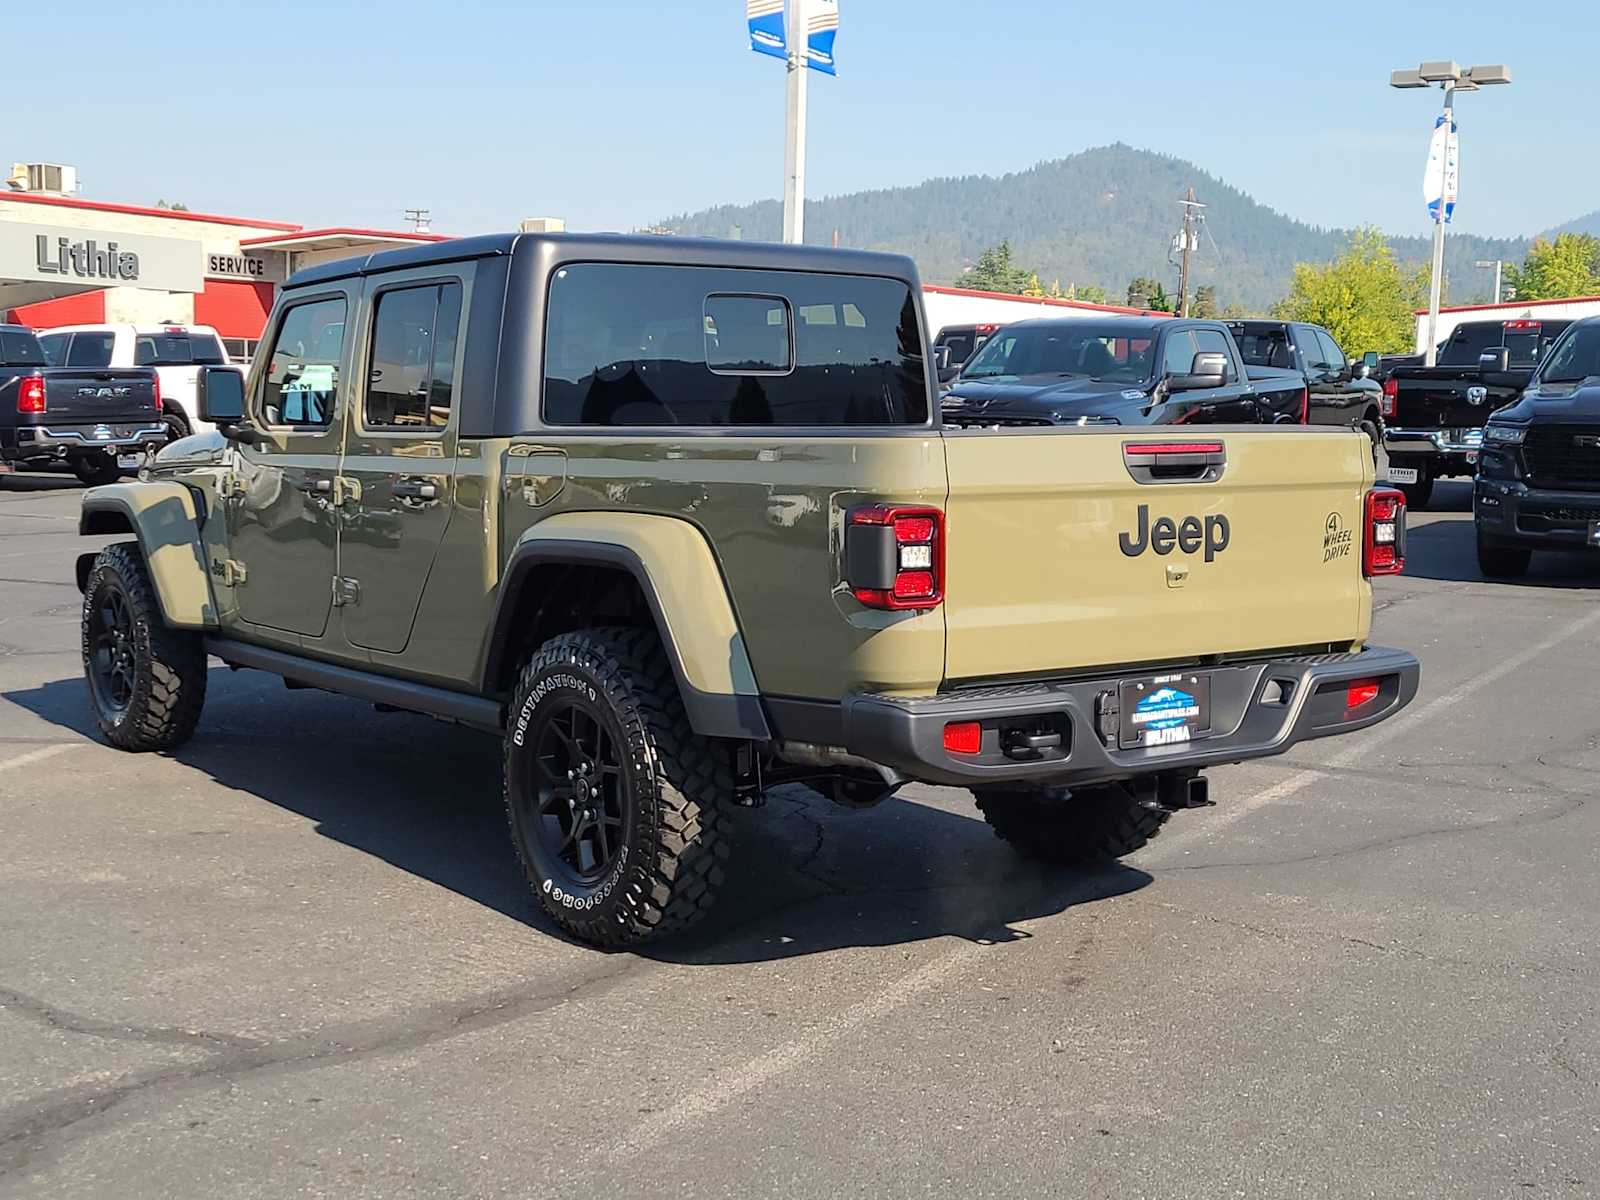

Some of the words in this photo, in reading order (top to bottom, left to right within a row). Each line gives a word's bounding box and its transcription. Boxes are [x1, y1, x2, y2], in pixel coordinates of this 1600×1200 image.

[36, 235, 140, 280] Lithia
[211, 256, 264, 275] SERVICE
[1118, 504, 1230, 563] Jeep
[1323, 530, 1352, 548] WHEEL
[1323, 543, 1351, 563] DRIVE
[513, 674, 588, 747] DESTINATION
